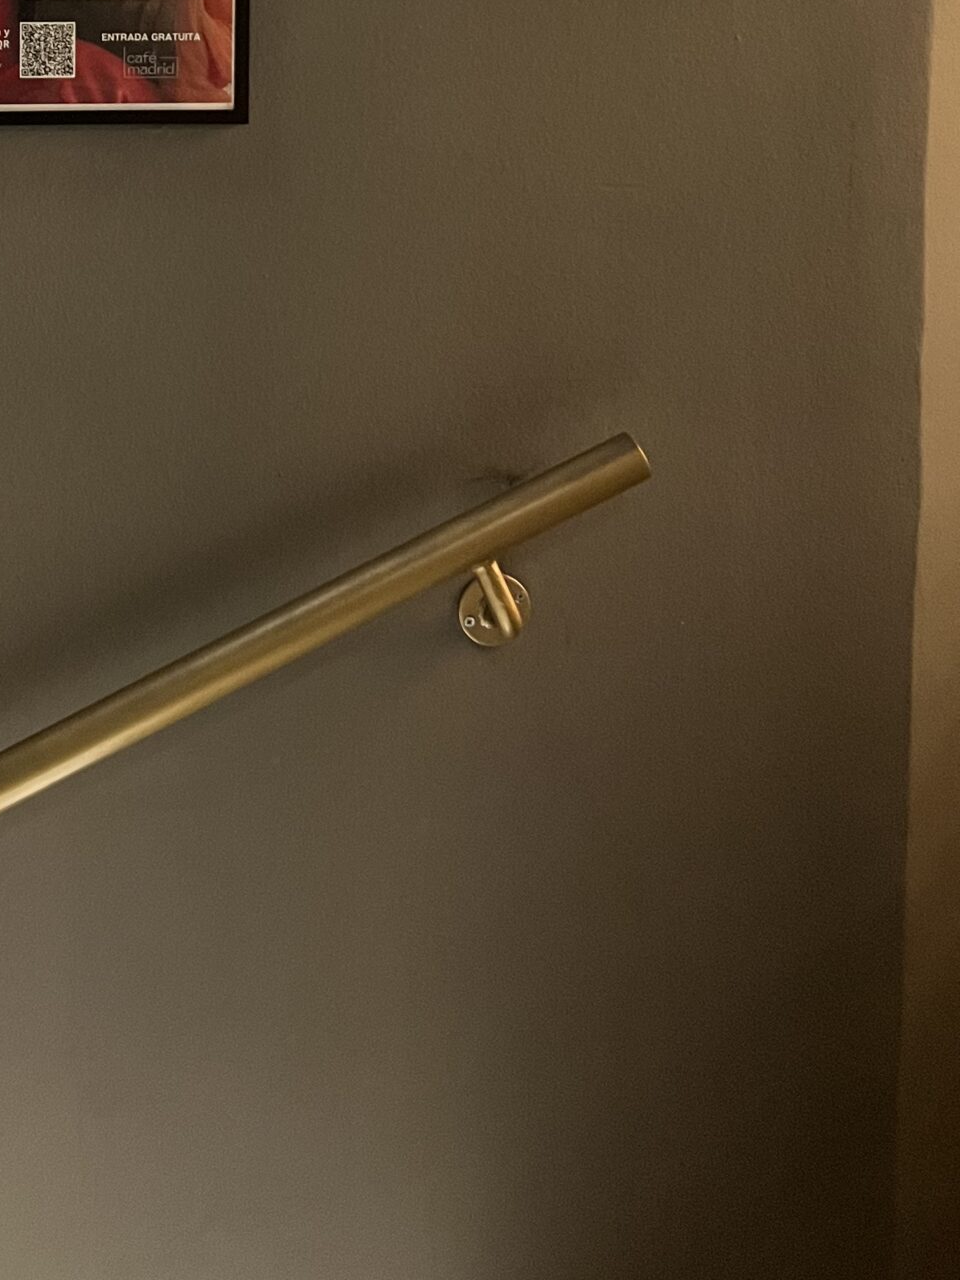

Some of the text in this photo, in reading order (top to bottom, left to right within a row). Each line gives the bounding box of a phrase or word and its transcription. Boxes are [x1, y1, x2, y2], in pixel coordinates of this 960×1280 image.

[3, 28, 10, 39] y
[101, 32, 201, 42] ENTRADA GRATUITA
[126, 49, 157, 64] café
[127, 62, 175, 75] madrid
